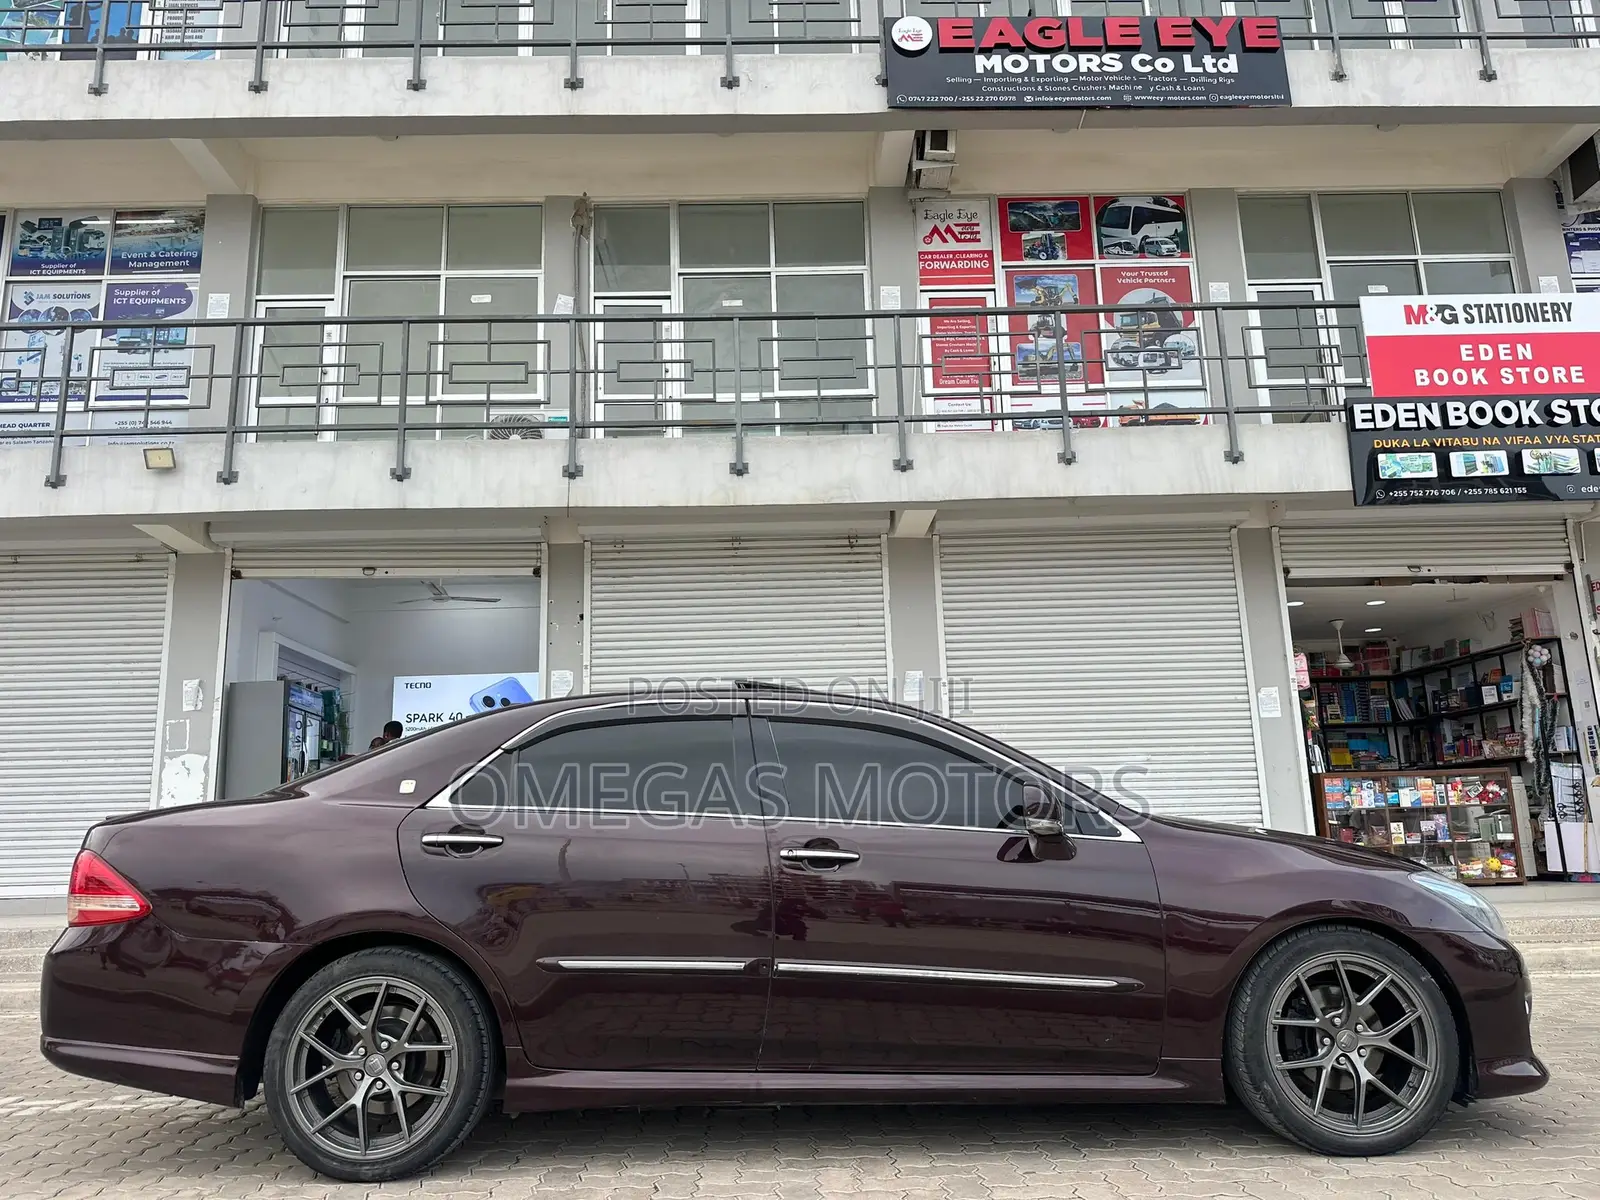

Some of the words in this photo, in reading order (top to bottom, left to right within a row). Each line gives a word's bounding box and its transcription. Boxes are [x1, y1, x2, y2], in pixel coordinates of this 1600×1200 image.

[937, 16, 1142, 50] EAGLE
[1155, 16, 1281, 50] EYE
[975, 53, 1123, 74] MOTORS
[1131, 53, 1175, 74] Co
[1182, 53, 1238, 74] Ltd
[946, 76, 972, 84] Selling
[983, 76, 1022, 84] Importing
[1031, 76, 1069, 84] Exporting
[1190, 76, 1217, 84] Drilling
[1218, 76, 1235, 84] Rigs
[924, 209, 954, 222] Eagle
[957, 208, 978, 222] Eye
[121, 251, 147, 259] Event
[150, 250, 156, 258] &
[159, 249, 198, 258] Catering
[128, 259, 190, 269] Management
[919, 260, 990, 269] FORWARDING
[114, 288, 150, 297] Supplier
[151, 288, 160, 296] of
[113, 297, 127, 305] ICT
[129, 297, 187, 305] EQUIPMENTS
[1403, 304, 1459, 325] M&G
[1462, 302, 1573, 325] STATIONERY
[1459, 343, 1533, 362] EDEN
[1414, 368, 1489, 387] BOOK
[1499, 366, 1585, 385] STORE
[1353, 402, 1441, 430] EDEN
[1446, 399, 1544, 427] BOOK
[1373, 437, 1410, 449] DUKA
[1413, 437, 1431, 448] LA
[1432, 436, 1479, 448] VITABU
[1482, 435, 1501, 447] NA
[1503, 435, 1542, 446] VIFAA
[1545, 435, 1571, 445] VYA
[1389, 490, 1408, 498] +255
[1409, 489, 1424, 497] 752
[1425, 489, 1440, 497] 776
[1463, 488, 1483, 496] +255
[1484, 488, 1498, 496] 785
[1499, 487, 1513, 495] 621
[1513, 487, 1527, 495] 155
[404, 682, 432, 690] TECNO
[405, 712, 444, 723] SPARK
[448, 711, 463, 721] 40
